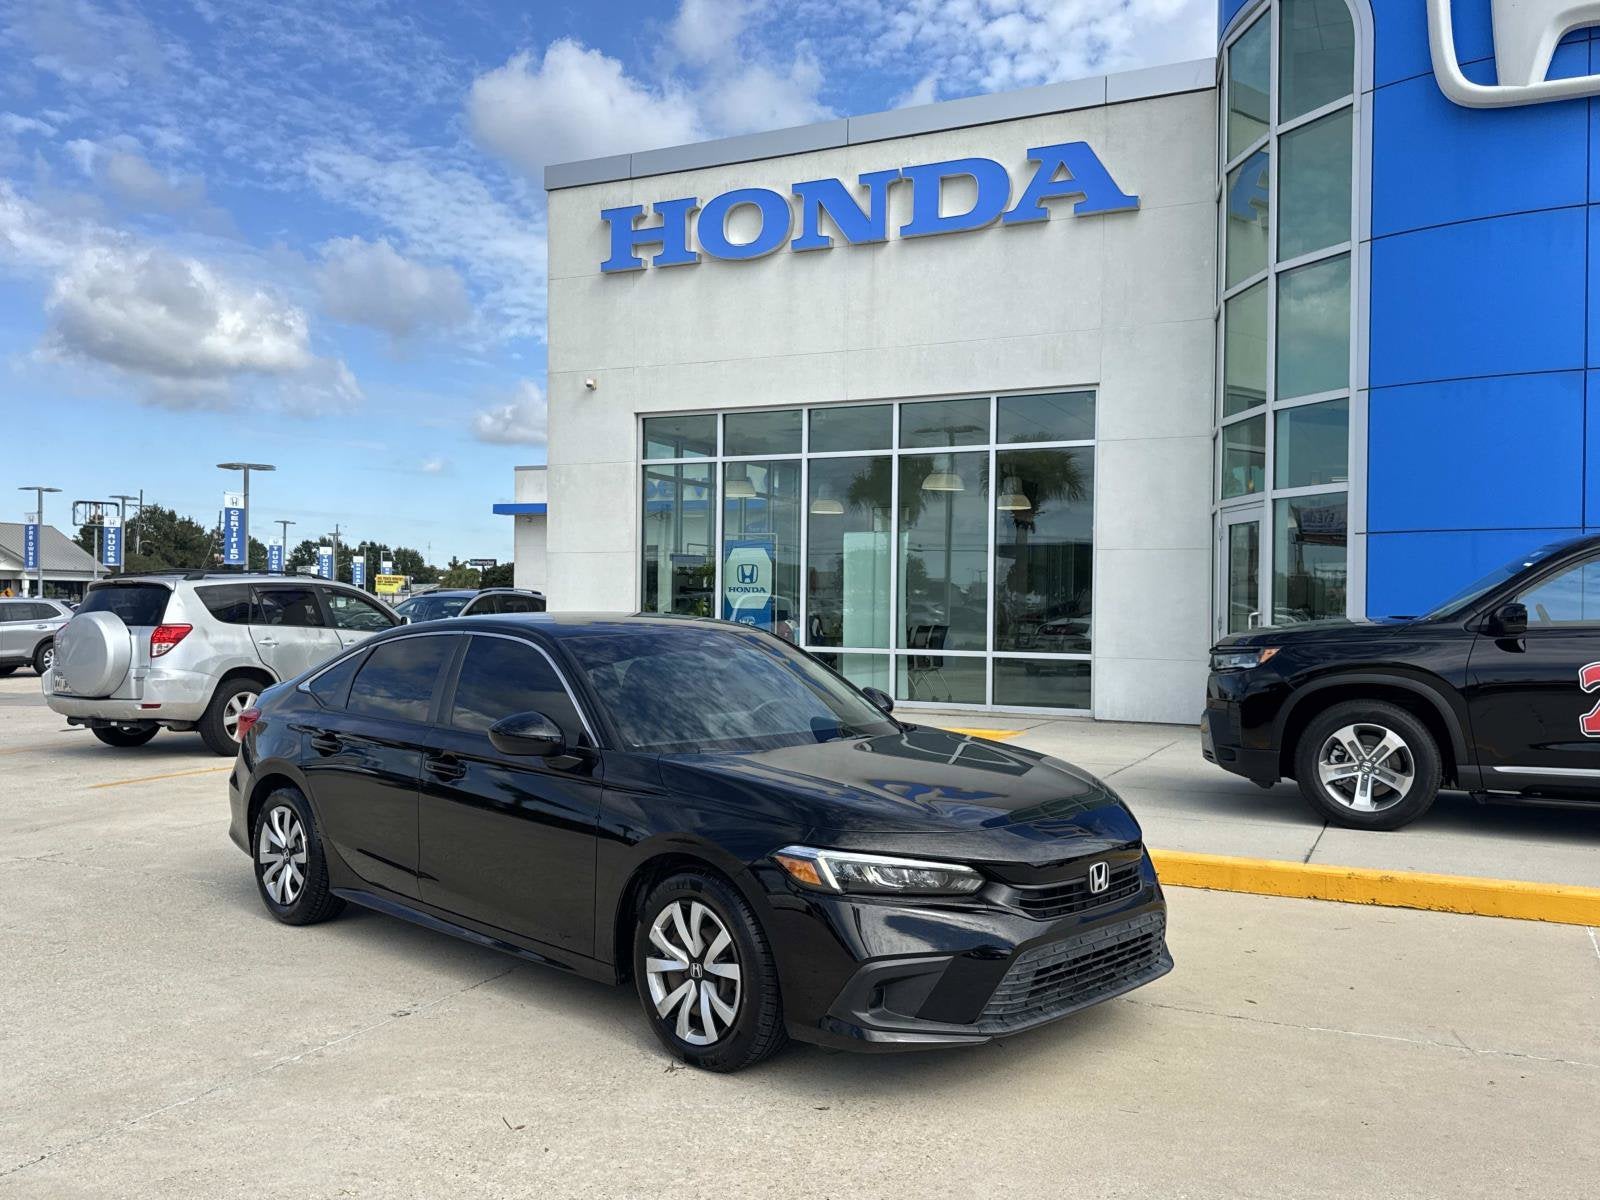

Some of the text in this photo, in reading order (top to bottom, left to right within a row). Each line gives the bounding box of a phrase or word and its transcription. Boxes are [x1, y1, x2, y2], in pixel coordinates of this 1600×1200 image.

[600, 141, 1140, 273] HONDA
[107, 528, 116, 562] TRUCKS
[230, 510, 239, 559] CERTIFIED
[271, 546, 279, 570] TRUCK
